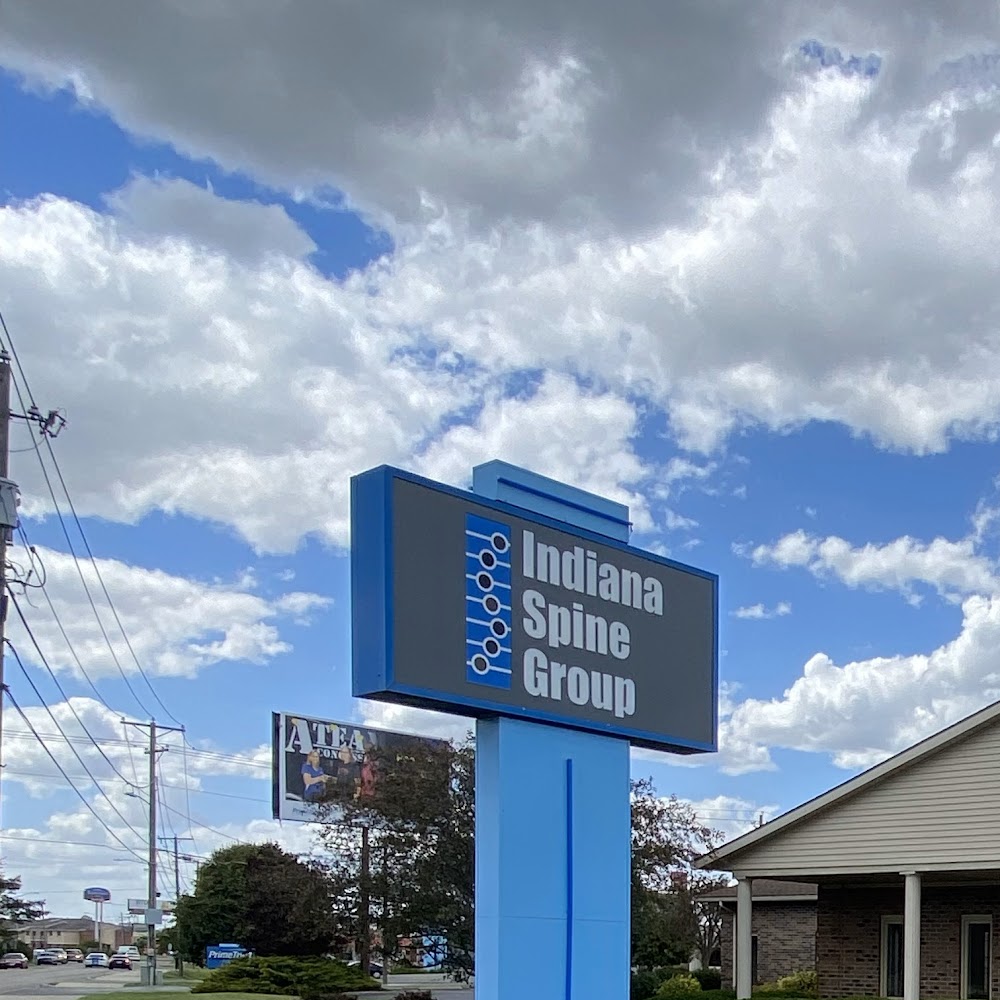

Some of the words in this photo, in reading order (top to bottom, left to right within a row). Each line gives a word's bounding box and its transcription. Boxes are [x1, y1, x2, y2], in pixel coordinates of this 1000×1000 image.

[523, 529, 663, 616] Indiana
[522, 589, 631, 660] Spine
[523, 648, 636, 718] Group
[208, 950, 252, 959] PrimeTrt
